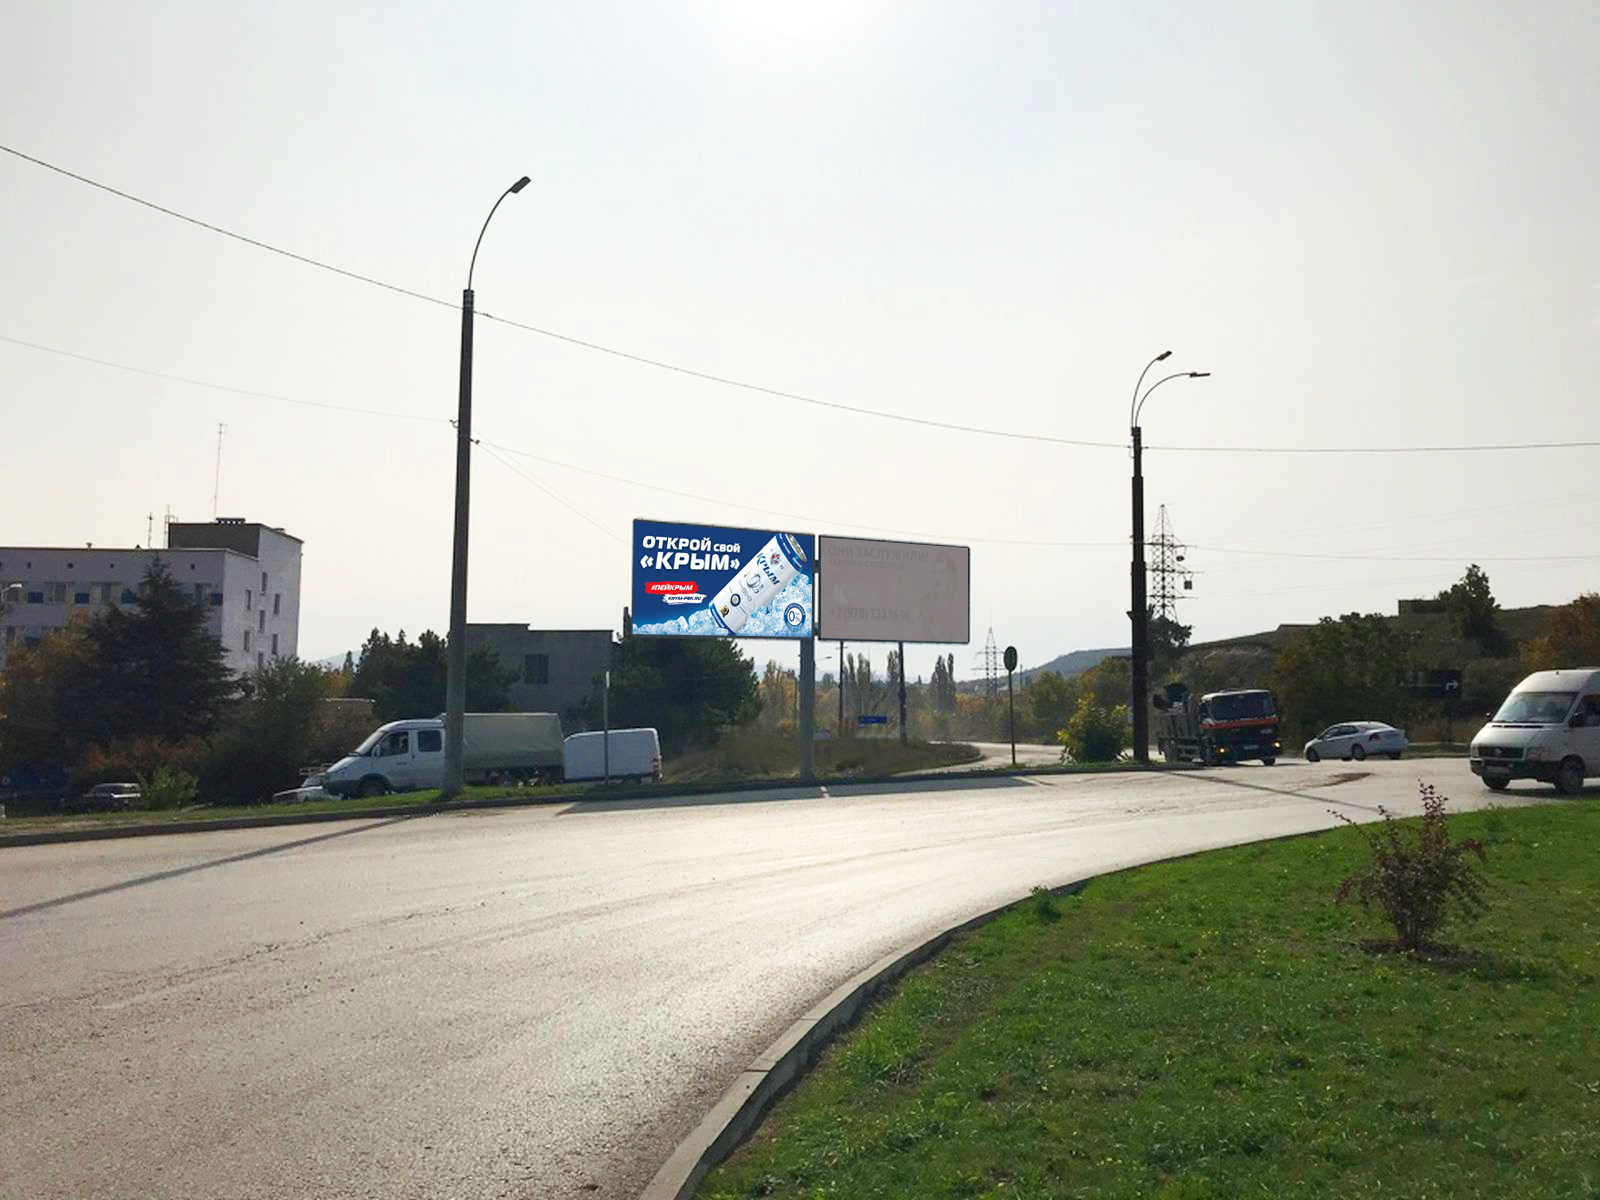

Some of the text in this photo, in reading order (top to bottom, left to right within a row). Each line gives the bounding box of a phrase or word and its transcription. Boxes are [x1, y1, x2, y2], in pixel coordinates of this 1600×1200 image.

[642, 535, 712, 552] ОТКРОЙ
[640, 551, 741, 571] «КРЫМ»
[828, 545, 929, 562] ОНИ ЗАСЛУЖИЛИ!
[650, 583, 694, 592] #ПЕЙКРЫМ
[830, 607, 910, 621] +7 (978) 733 16 16
